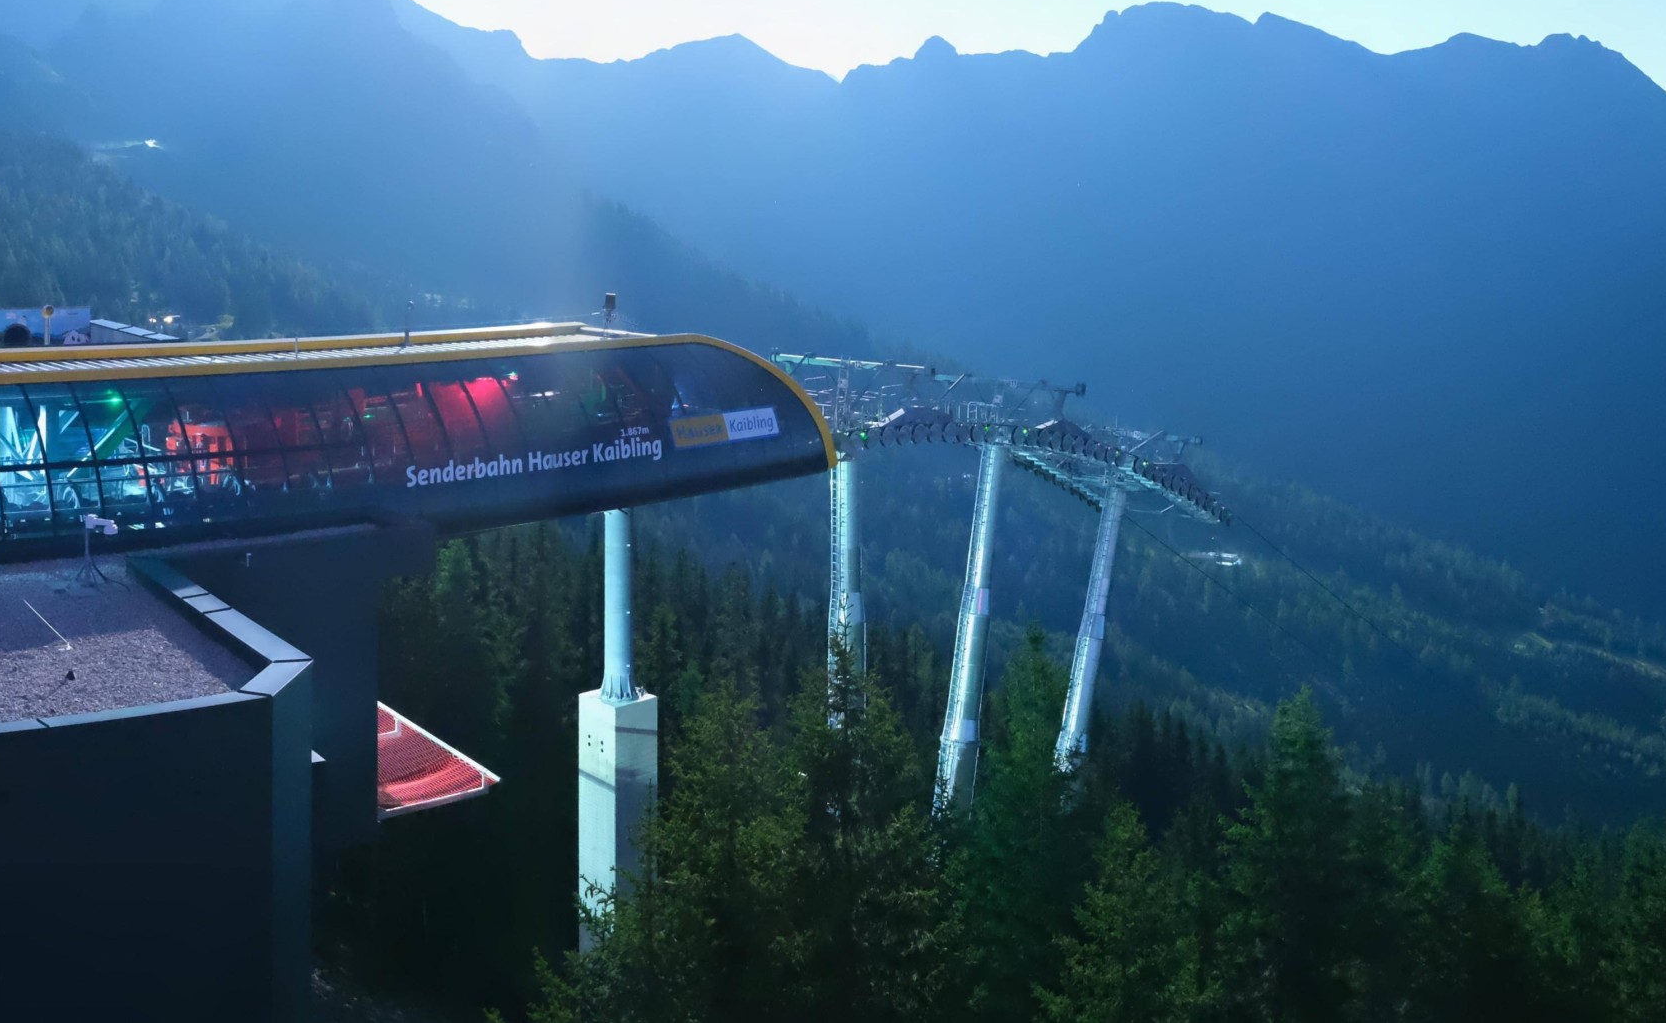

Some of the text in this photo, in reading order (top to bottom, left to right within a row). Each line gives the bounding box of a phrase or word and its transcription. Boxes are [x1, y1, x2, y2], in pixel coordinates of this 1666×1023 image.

[620, 426, 650, 437] 1.867m
[729, 415, 774, 433] Kaibling
[406, 435, 662, 488] Senderbahn Hauser Kaibling
